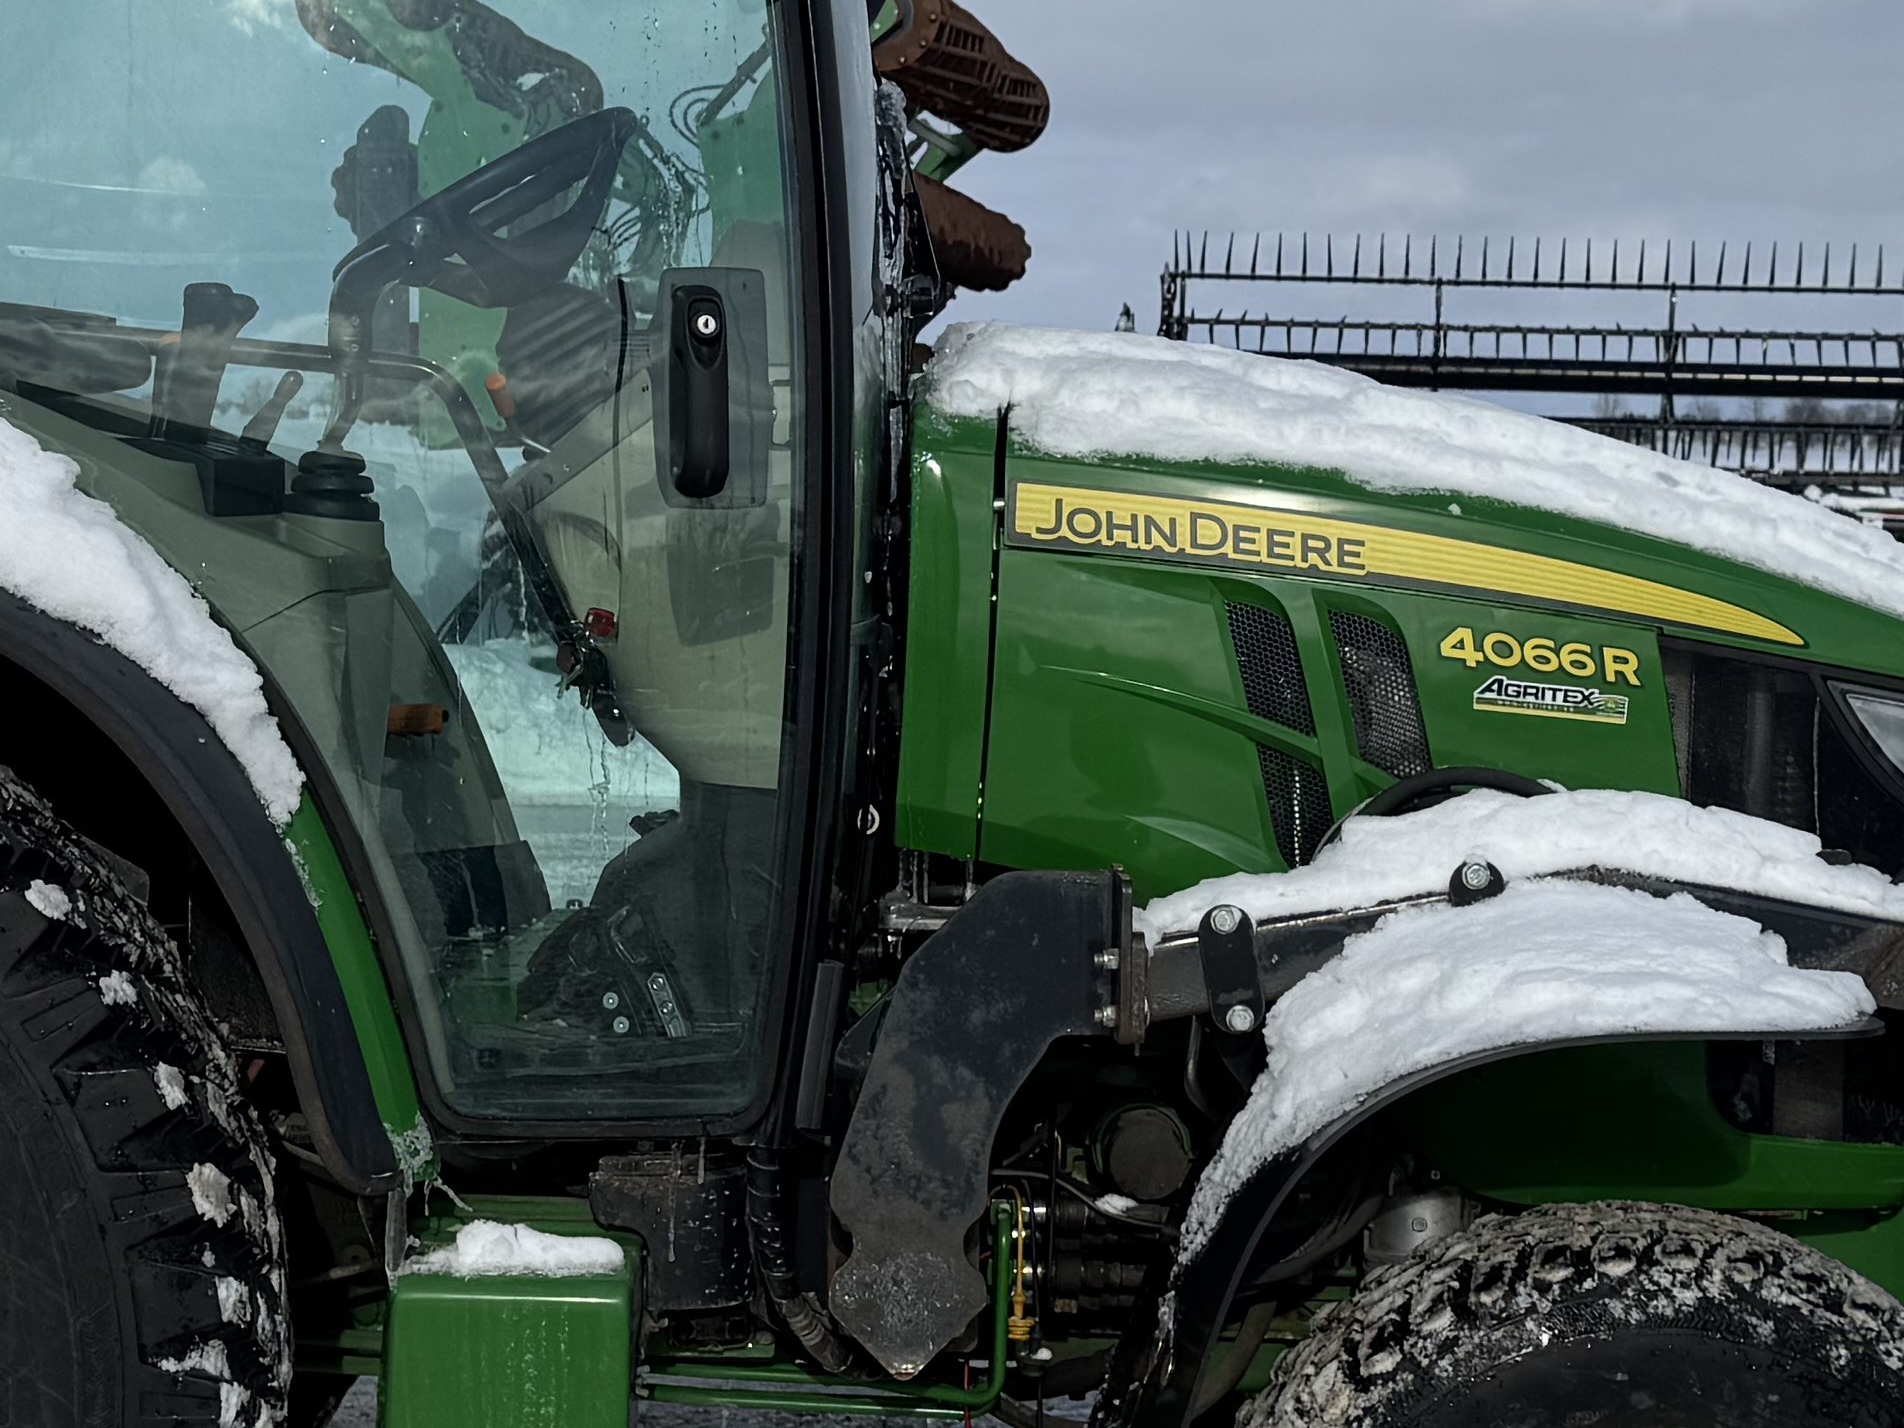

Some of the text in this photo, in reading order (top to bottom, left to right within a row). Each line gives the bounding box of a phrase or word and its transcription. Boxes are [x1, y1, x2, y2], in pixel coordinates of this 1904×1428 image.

[1036, 498, 1366, 570] JOHN DEERE
[1477, 678, 1596, 705] AGRITEX
